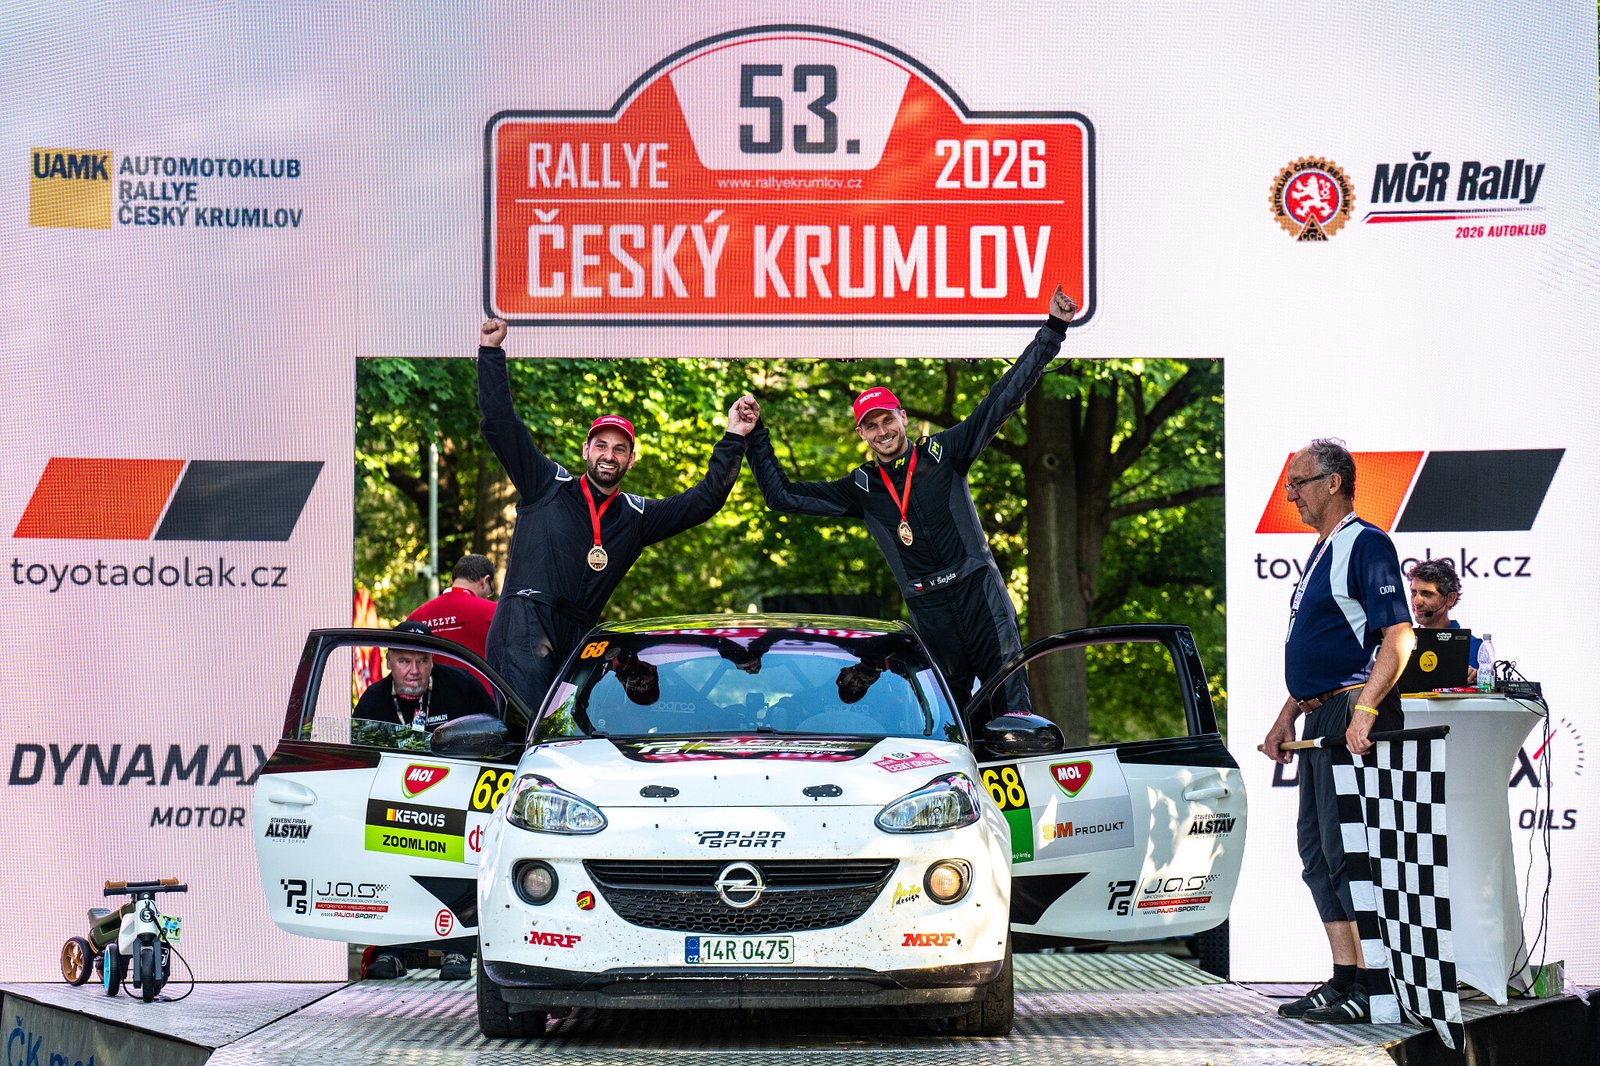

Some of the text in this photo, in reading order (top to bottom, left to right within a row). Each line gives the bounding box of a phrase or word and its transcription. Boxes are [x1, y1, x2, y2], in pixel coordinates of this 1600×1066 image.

[738, 63, 861, 155] 53.
[33, 152, 109, 181] UAMK
[119, 155, 302, 179] AUTOMOTOKLUB
[527, 141, 669, 190] RALLYE
[934, 138, 1047, 190] 2026
[717, 176, 863, 191] www.rallyekrumlov.cz
[1370, 151, 1546, 205] MČR Rally
[119, 180, 198, 203] RALLYE
[118, 201, 303, 229] ČESKÝ KRUMLOV
[1455, 223, 1547, 239] 2026 AUTOKLUB
[526, 208, 1052, 299] ČESKÝ KRUMLOV
[11, 556, 288, 593] toyotadolak.cz
[580, 641, 609, 659] 68
[407, 768, 435, 783] MOL
[1057, 766, 1082, 781] MOL
[473, 769, 514, 811] 68
[983, 767, 1026, 810] 68
[150, 807, 246, 828] MOTOR
[1187, 817, 1236, 836] ALSTAV
[1519, 809, 1577, 830] OILS
[264, 823, 313, 839] ALSTAV
[694, 830, 786, 845] PAJDA
[1043, 821, 1125, 840] SM PRODUKT
[382, 834, 447, 854] ZOOMLION
[708, 839, 782, 848] SPORT
[891, 882, 921, 909] Auto
[896, 894, 920, 906] design
[143, 910, 151, 920] 5
[529, 931, 582, 949] MRF
[901, 933, 955, 947] MRF
[687, 940, 790, 963] CZ 14R 0475
